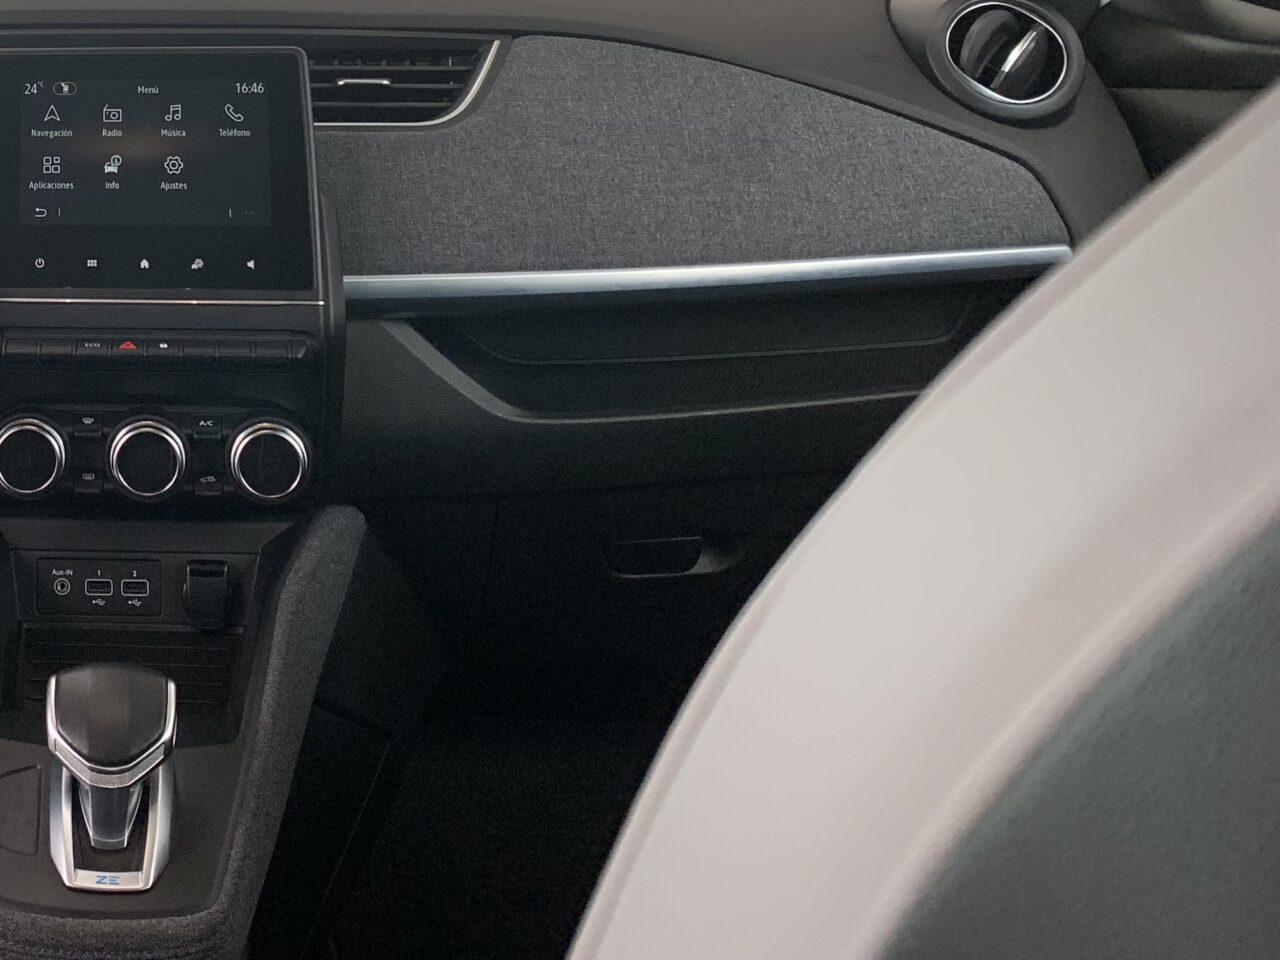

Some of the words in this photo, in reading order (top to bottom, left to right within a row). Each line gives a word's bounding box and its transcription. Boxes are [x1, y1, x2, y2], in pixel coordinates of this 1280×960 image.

[137, 84, 159, 95] Menú
[235, 83, 265, 95] 16:46
[31, 128, 73, 139] Navegación
[102, 128, 123, 138] Radio
[161, 128, 186, 138] Música
[219, 128, 251, 138] Teléfono
[29, 180, 74, 191] Aplicaciones
[105, 181, 120, 190] Info
[160, 181, 188, 191] Ajustes
[199, 419, 214, 428] A/C
[95, 875, 120, 885] ZE
